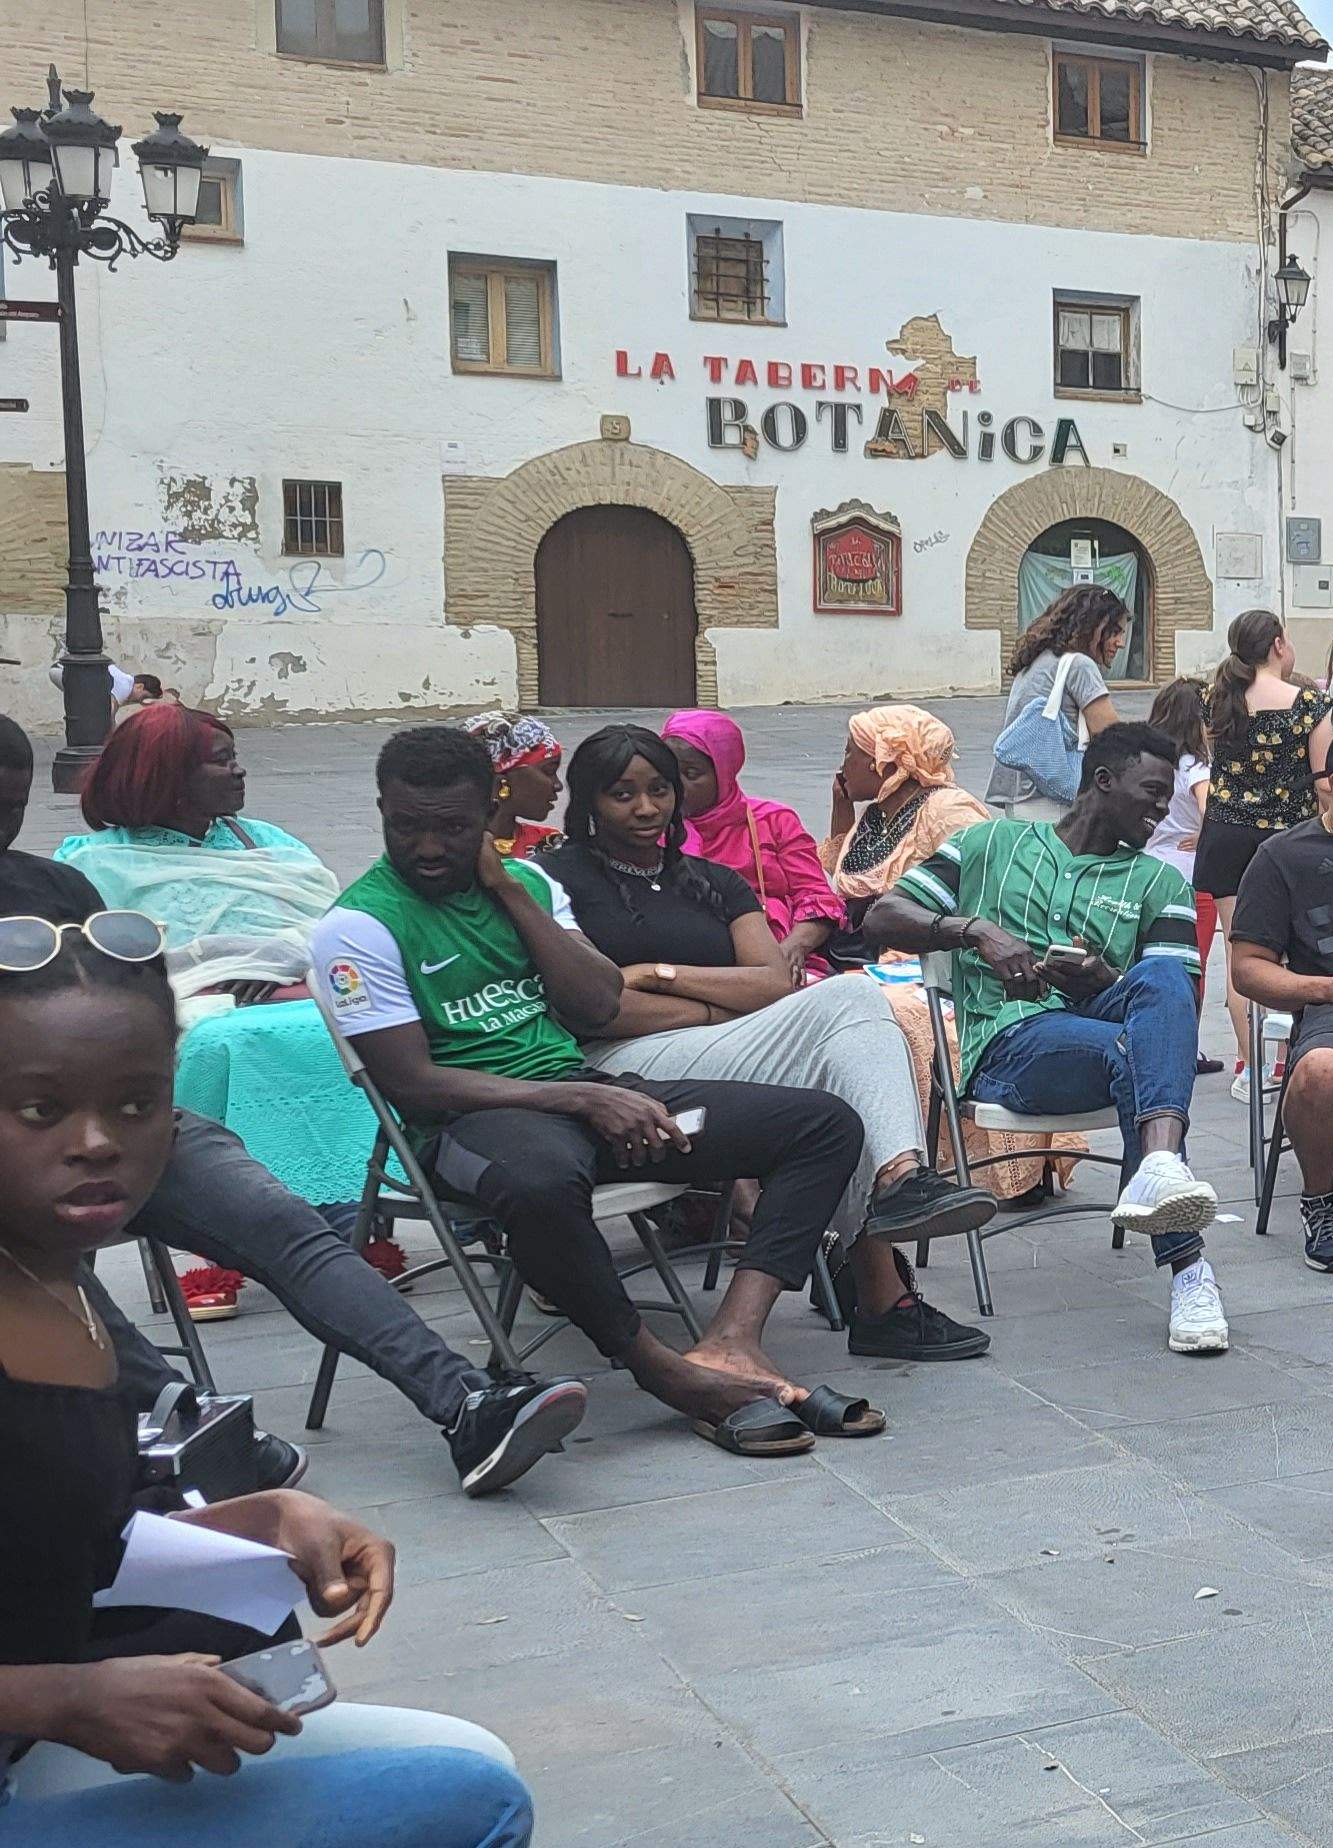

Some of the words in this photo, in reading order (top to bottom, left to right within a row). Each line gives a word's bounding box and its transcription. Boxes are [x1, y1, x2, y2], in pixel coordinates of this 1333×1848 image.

[614, 350, 676, 379] LA
[703, 356, 920, 400] TABERNA
[947, 376, 981, 393] DE
